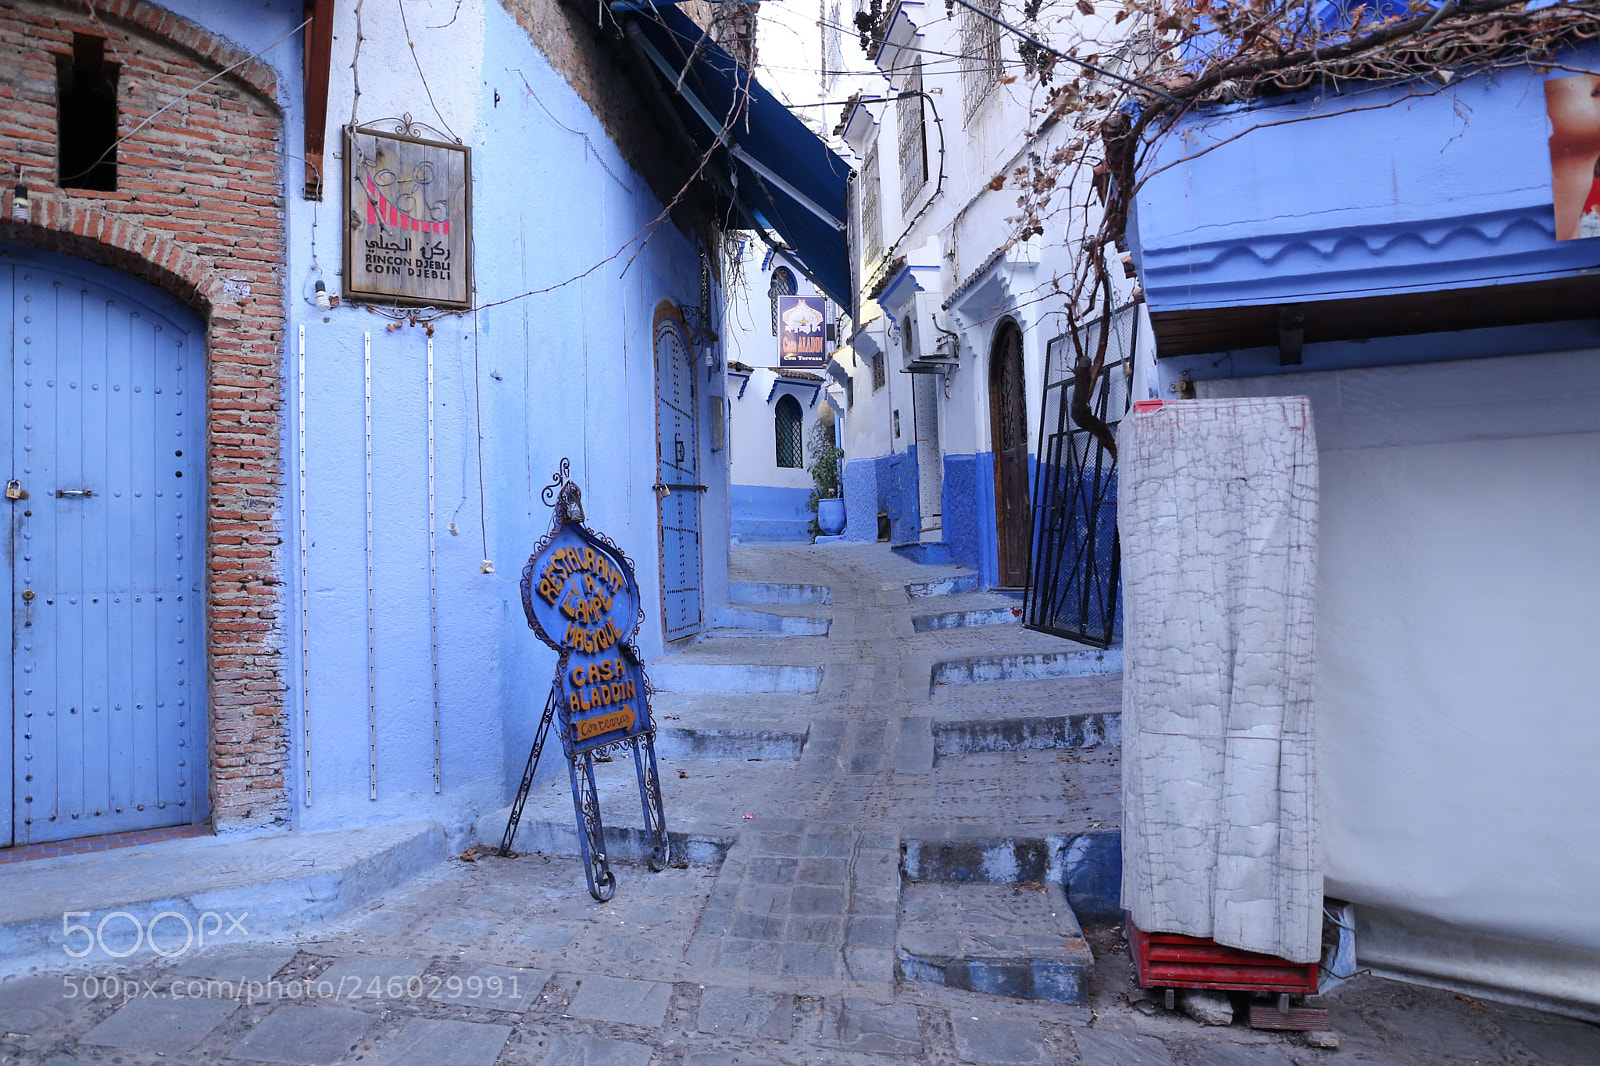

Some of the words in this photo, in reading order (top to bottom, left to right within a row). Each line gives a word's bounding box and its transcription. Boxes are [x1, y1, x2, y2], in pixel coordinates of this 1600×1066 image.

[365, 254, 412, 266] RINCON
[416, 259, 450, 271] DJEBLI
[420, 241, 451, 261] ركن
[366, 264, 401, 275] COIN
[408, 267, 450, 280] DJEBLI
[798, 336, 823, 353] ALADIN
[539, 546, 624, 605] RESTAURANT
[570, 573, 596, 595] LA
[563, 587, 613, 624] LAMPE
[564, 616, 622, 653] MAGIQUE
[573, 658, 625, 686] CASA
[570, 679, 636, 712] ALADDIN
